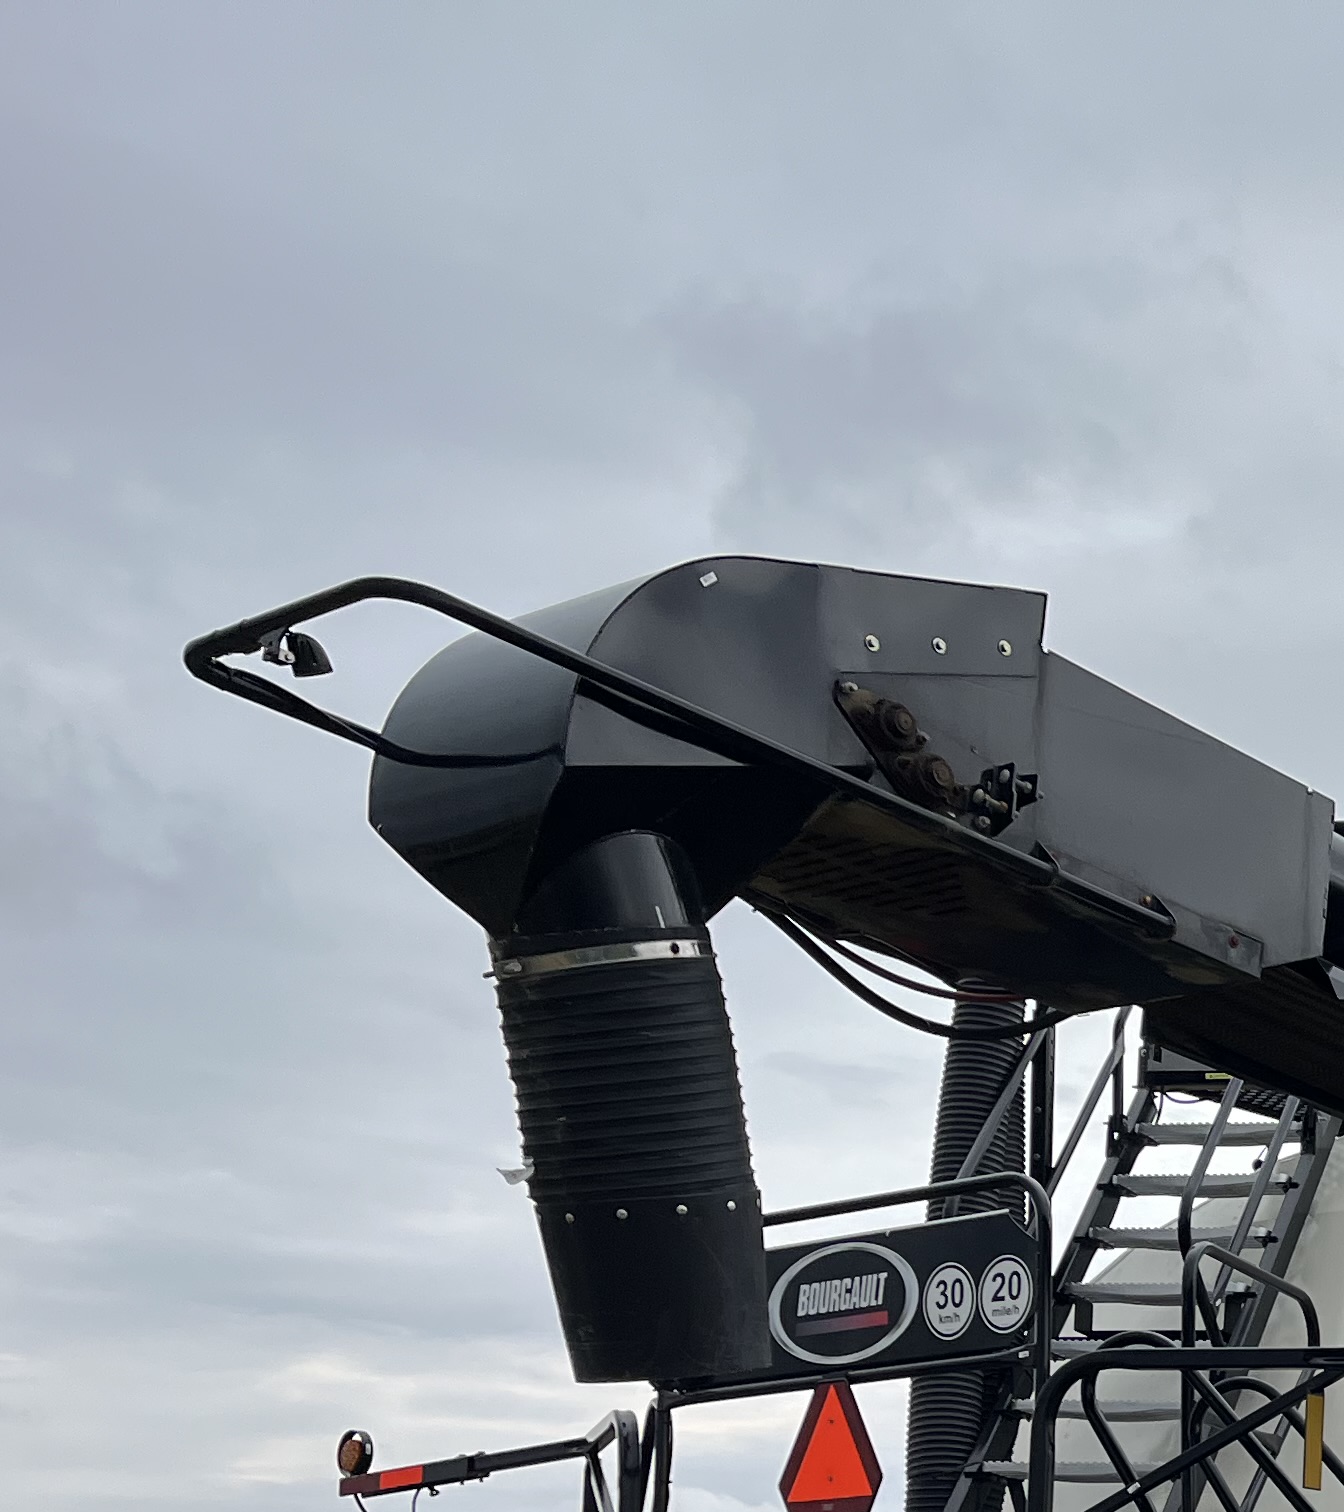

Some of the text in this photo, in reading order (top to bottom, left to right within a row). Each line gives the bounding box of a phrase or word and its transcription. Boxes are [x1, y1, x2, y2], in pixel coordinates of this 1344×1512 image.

[797, 1272, 889, 1317] BOURGAULT
[935, 1278, 964, 1310] 30
[990, 1270, 1022, 1303] 20
[938, 1313, 961, 1325] km/h
